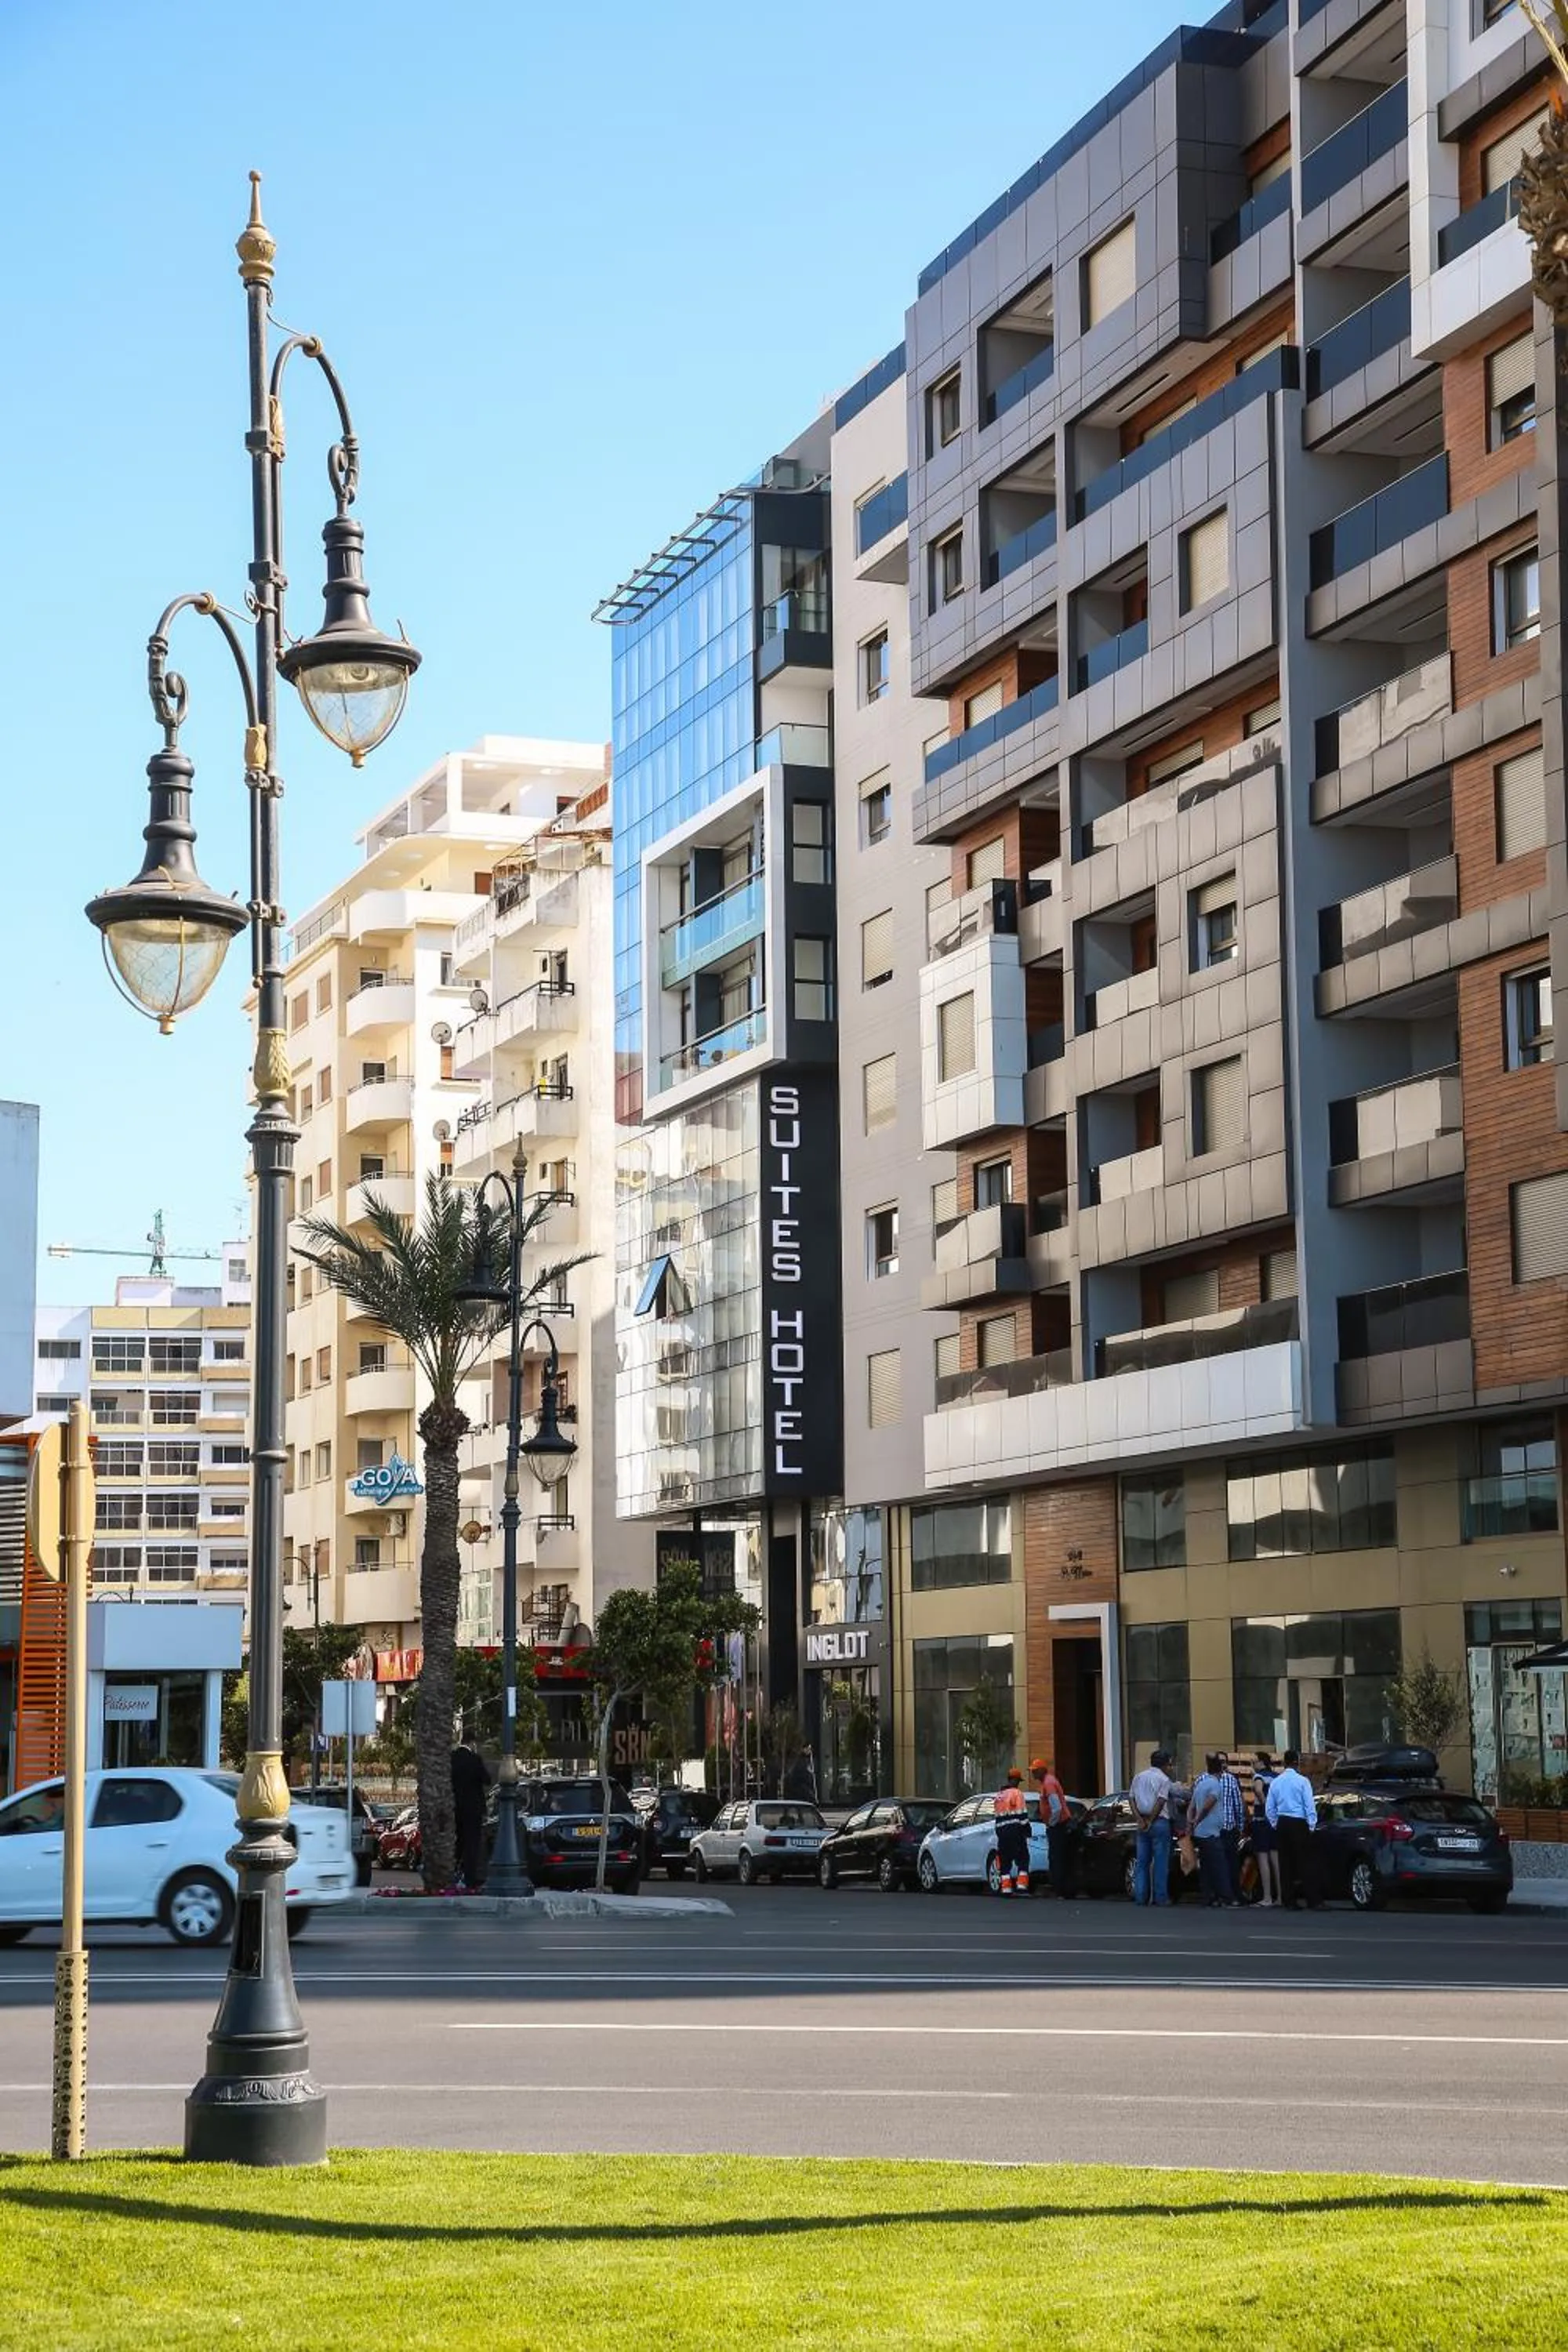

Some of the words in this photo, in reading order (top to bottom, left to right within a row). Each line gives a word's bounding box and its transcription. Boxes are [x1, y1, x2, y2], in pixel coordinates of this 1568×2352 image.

[769, 1085, 801, 1283] SUITES
[771, 1310, 804, 1474] HOTEL
[361, 1463, 416, 1493] GOYA
[807, 1631, 869, 1661] INGLOT
